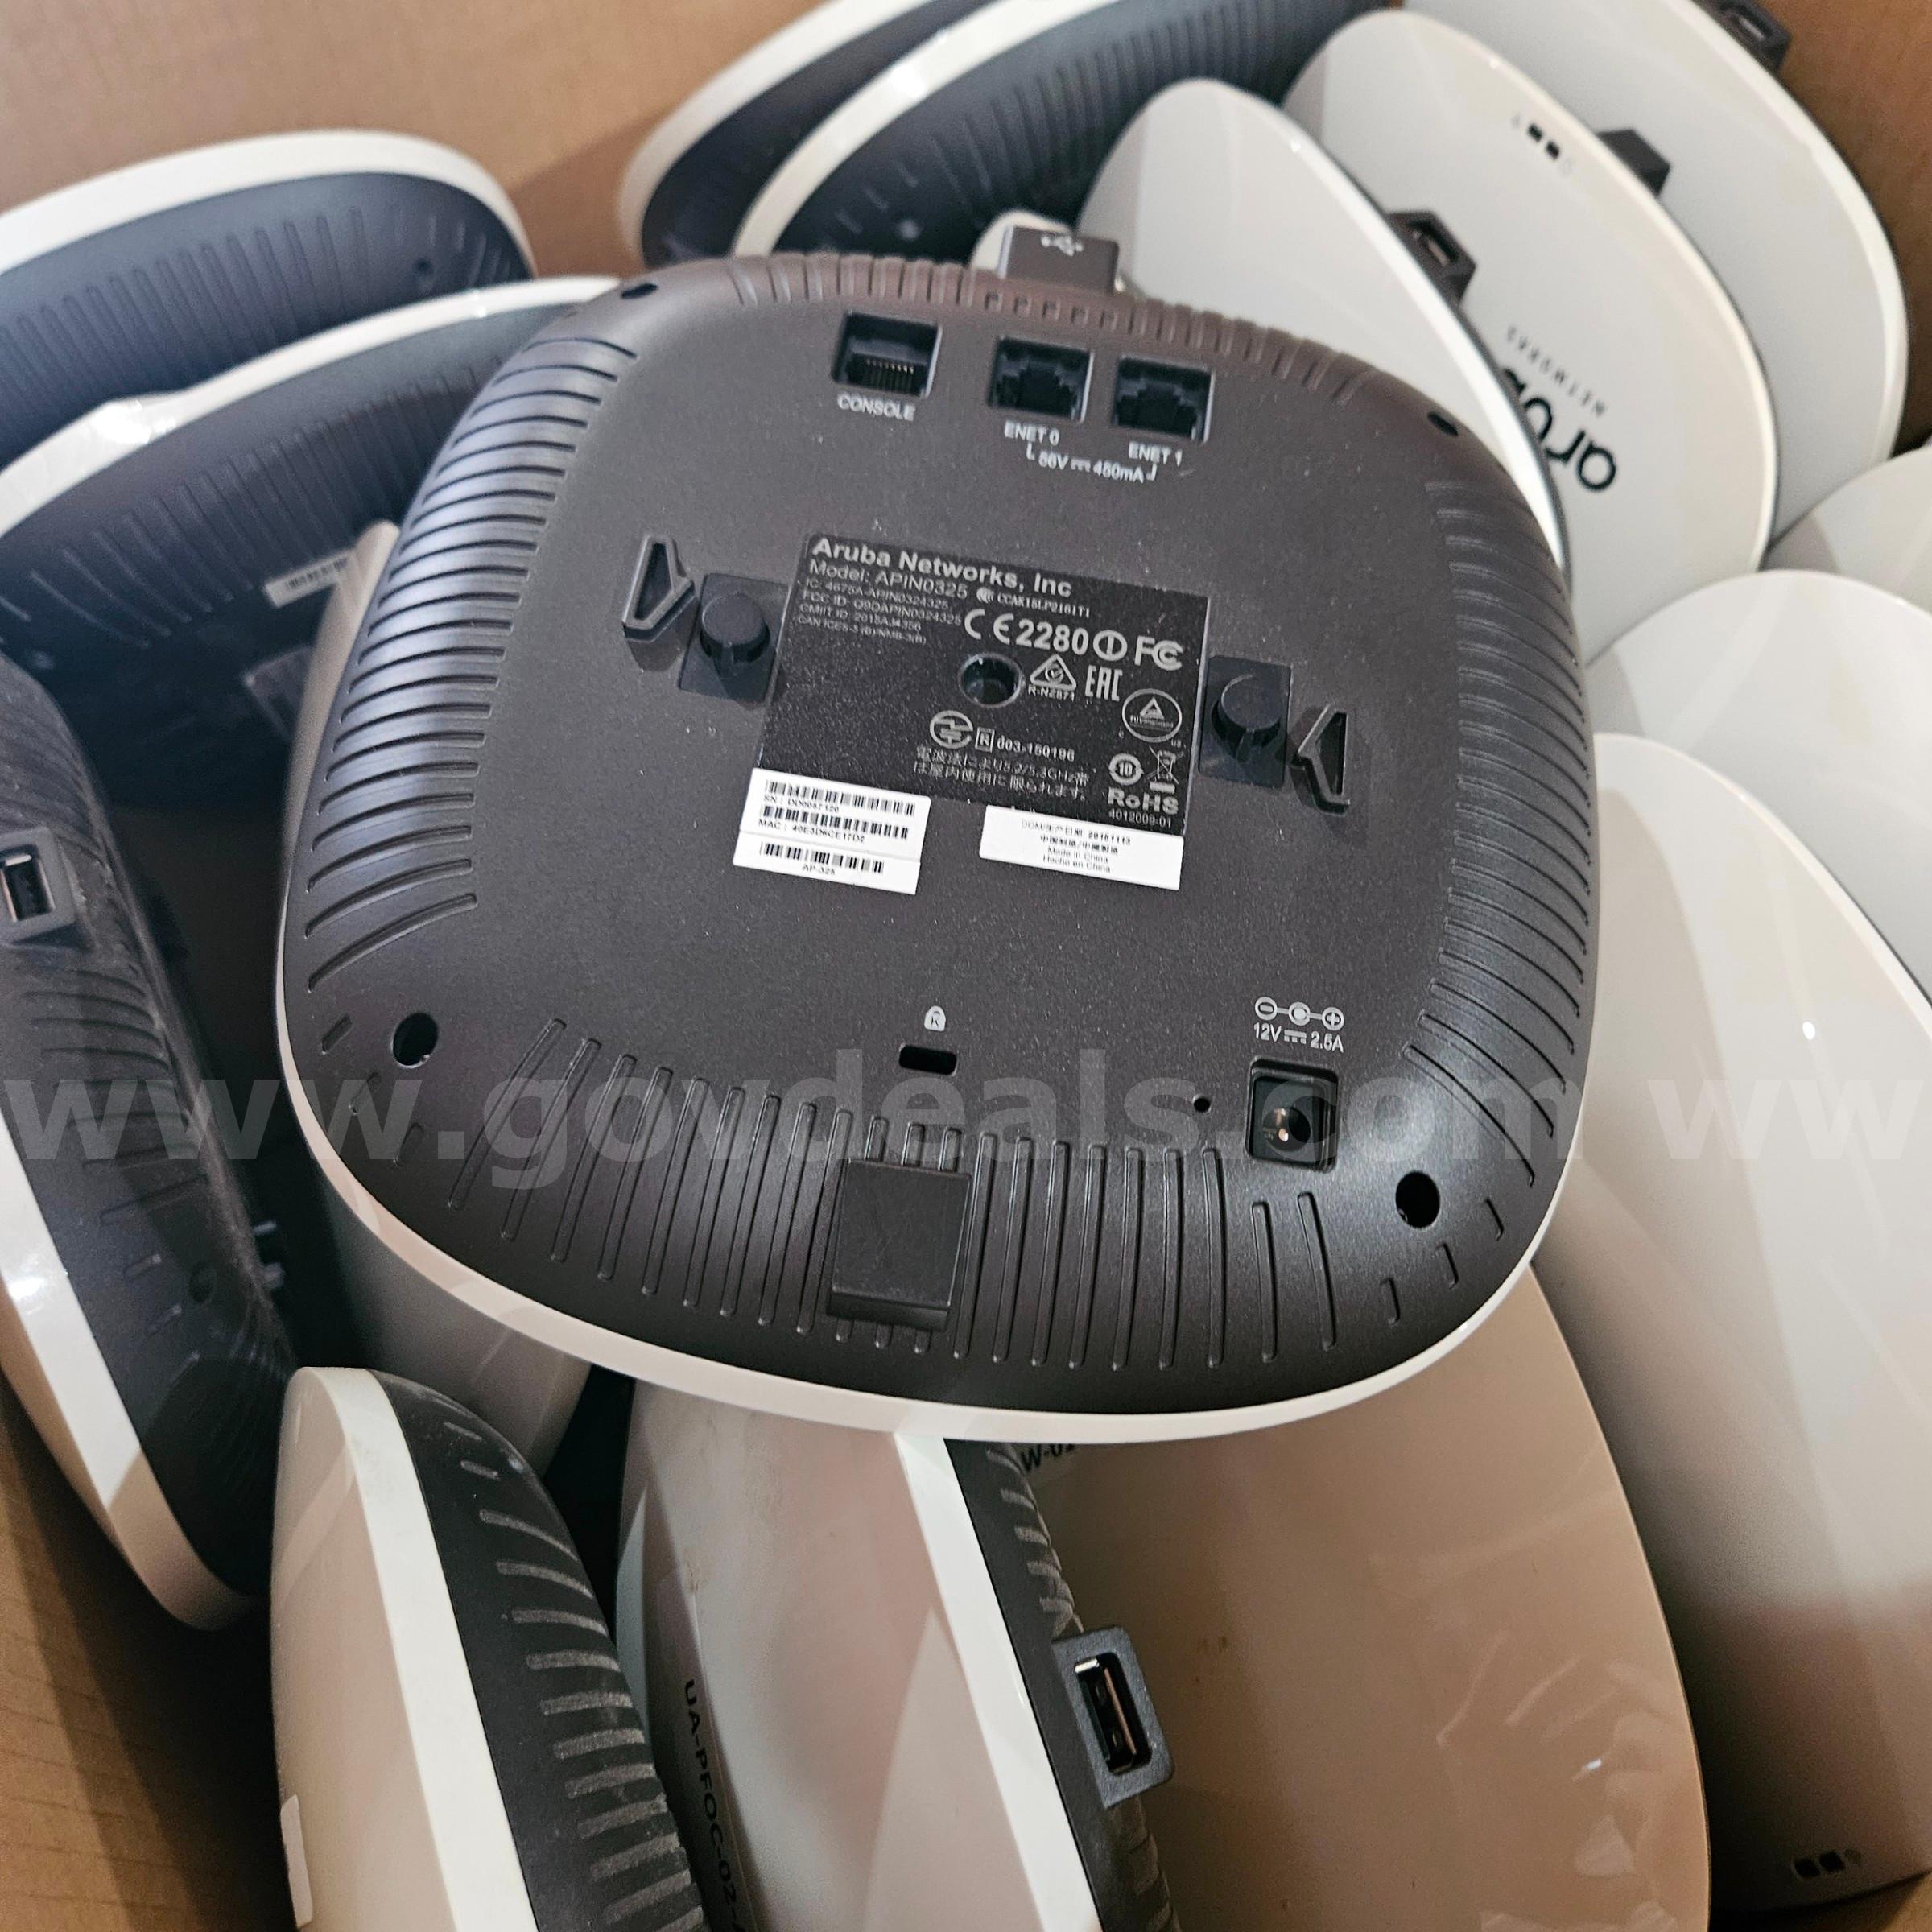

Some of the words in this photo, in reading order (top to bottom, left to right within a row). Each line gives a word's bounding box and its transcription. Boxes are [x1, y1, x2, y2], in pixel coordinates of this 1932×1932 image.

[836, 393, 916, 422] CONSOLE
[1004, 420, 1047, 444] ENET
[1049, 427, 1060, 446] 0
[1128, 440, 1171, 465] ENET
[1174, 448, 1183, 467] 1
[808, 558, 870, 583] Model:
[874, 569, 968, 600] APIN0325
[811, 536, 892, 567] Aruba
[898, 550, 1025, 593] Networks,
[1033, 572, 1072, 598] Inc
[802, 590, 830, 605] FCC
[797, 614, 821, 627] CAN
[1118, 761, 1133, 778] 10
[1107, 786, 1179, 815] RoHS
[1042, 855, 1071, 869] Hecho
[1072, 858, 1084, 869] en
[1086, 860, 1111, 874] China
[1047, 847, 1072, 860] Made
[1084, 852, 1108, 865] China
[1253, 1022, 1282, 1042] 12V
[1310, 1030, 1344, 1054] 2.5A
